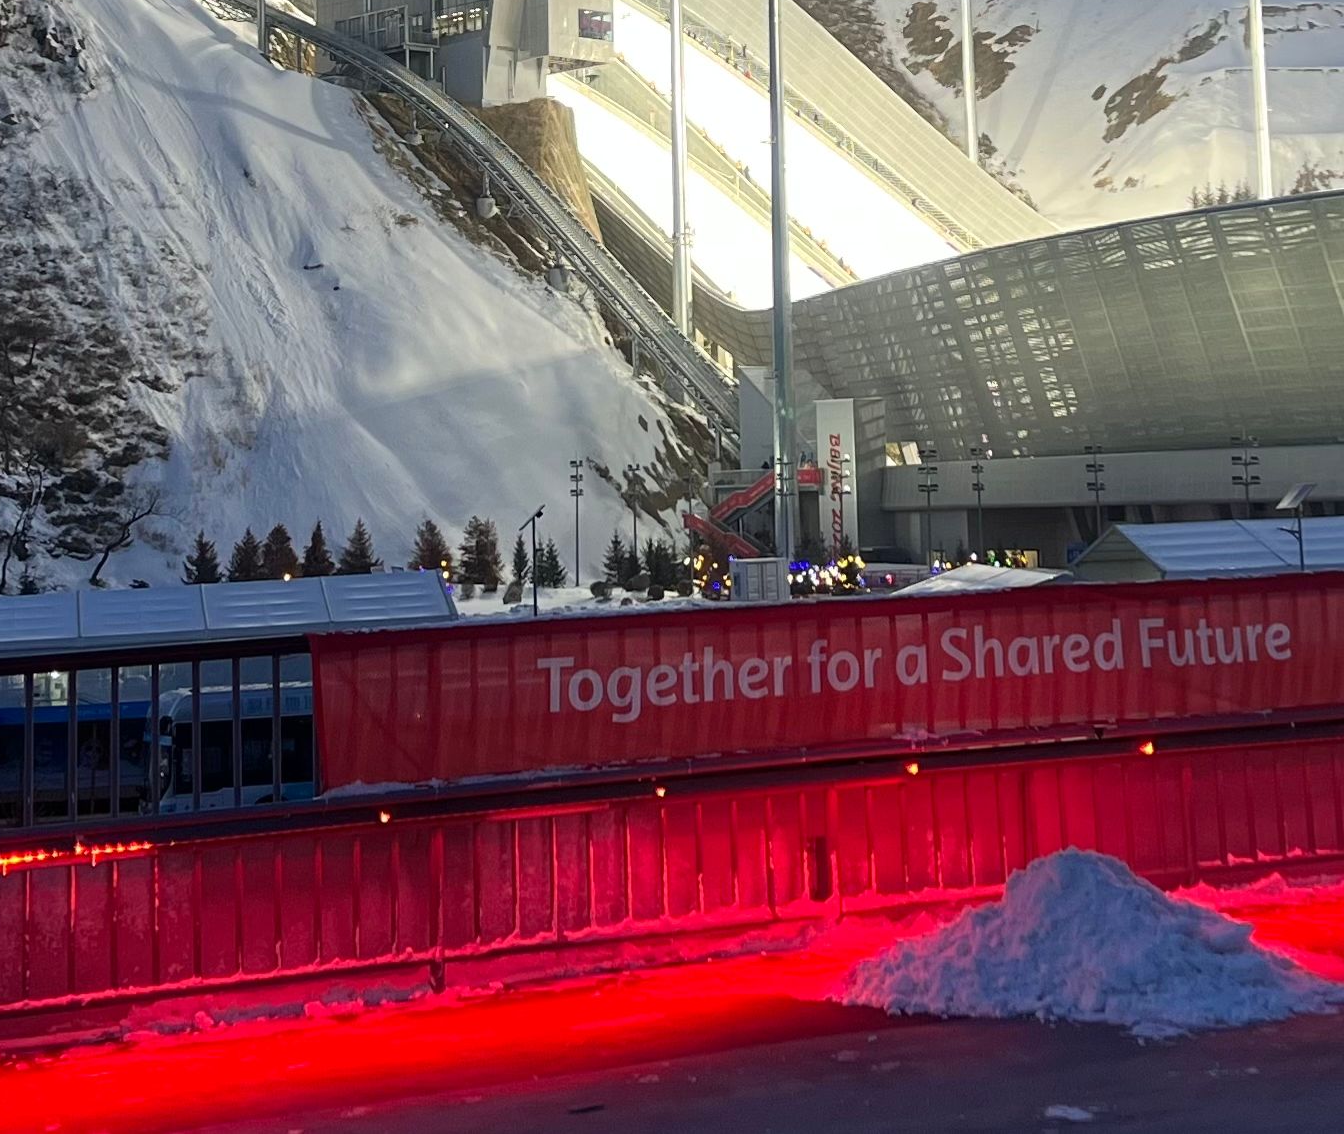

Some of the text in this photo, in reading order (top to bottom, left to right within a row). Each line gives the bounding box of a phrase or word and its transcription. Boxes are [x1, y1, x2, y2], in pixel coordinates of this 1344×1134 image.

[537, 618, 1292, 723] Together for a Shared Future
